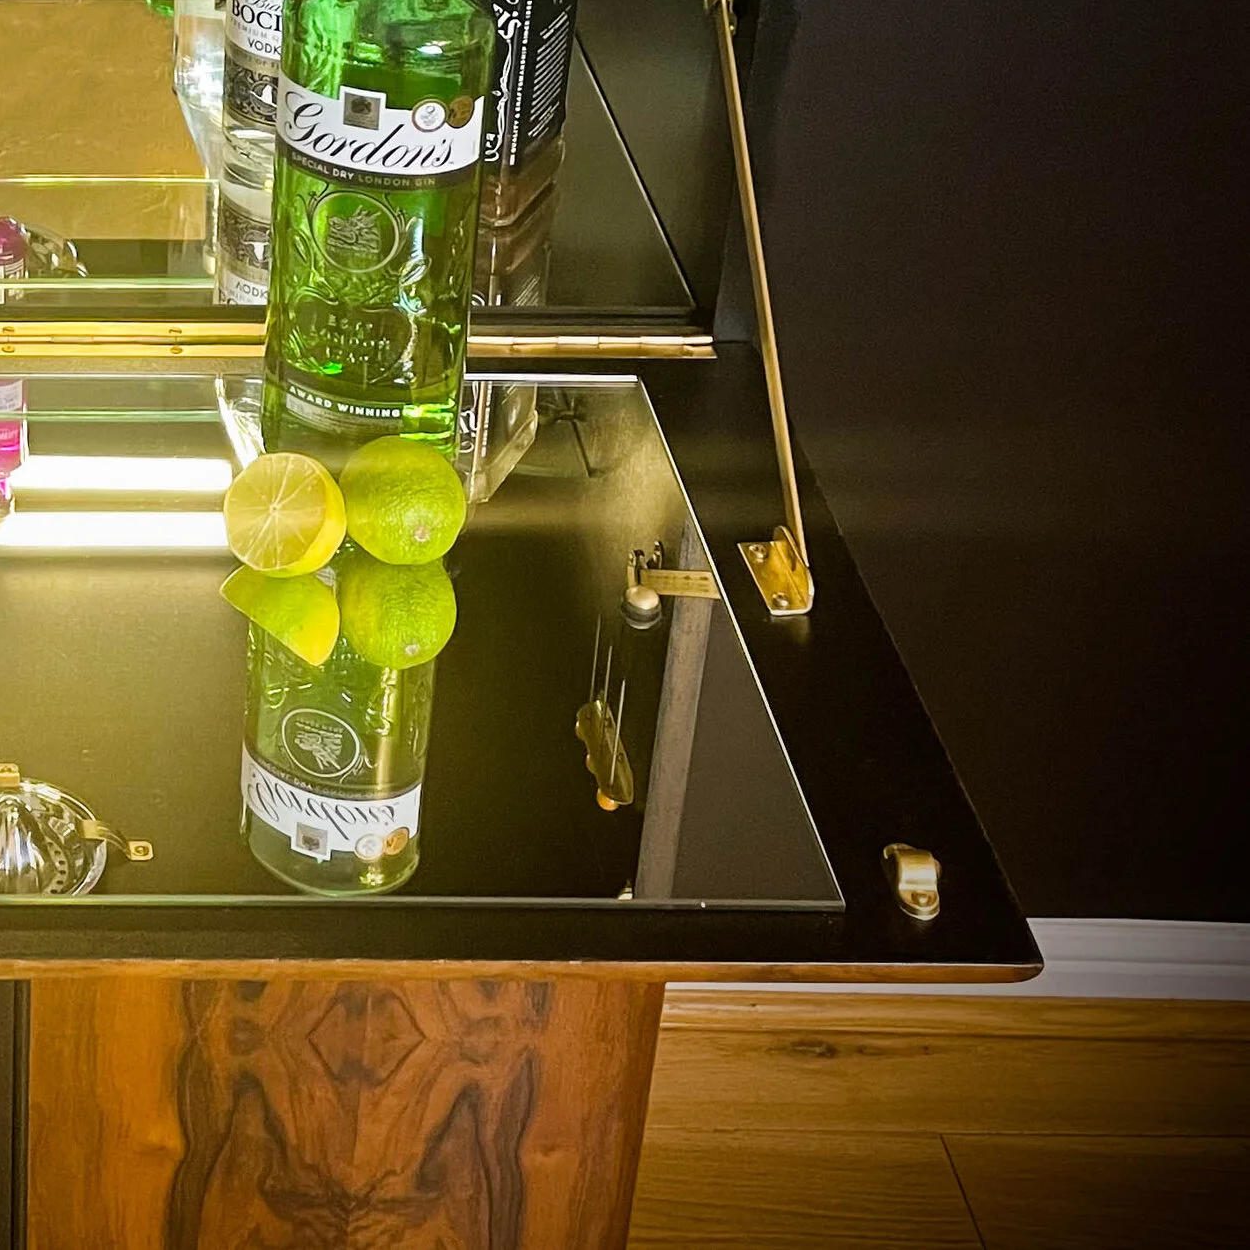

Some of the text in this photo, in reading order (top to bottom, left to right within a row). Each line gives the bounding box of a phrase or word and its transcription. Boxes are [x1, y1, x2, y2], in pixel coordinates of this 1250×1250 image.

[248, 37, 282, 56] VODK
[285, 91, 454, 169] Gordon's
[290, 152, 436, 187] SPECIAL DRY LONDON GIN
[289, 385, 400, 418] AWARD WINNING
